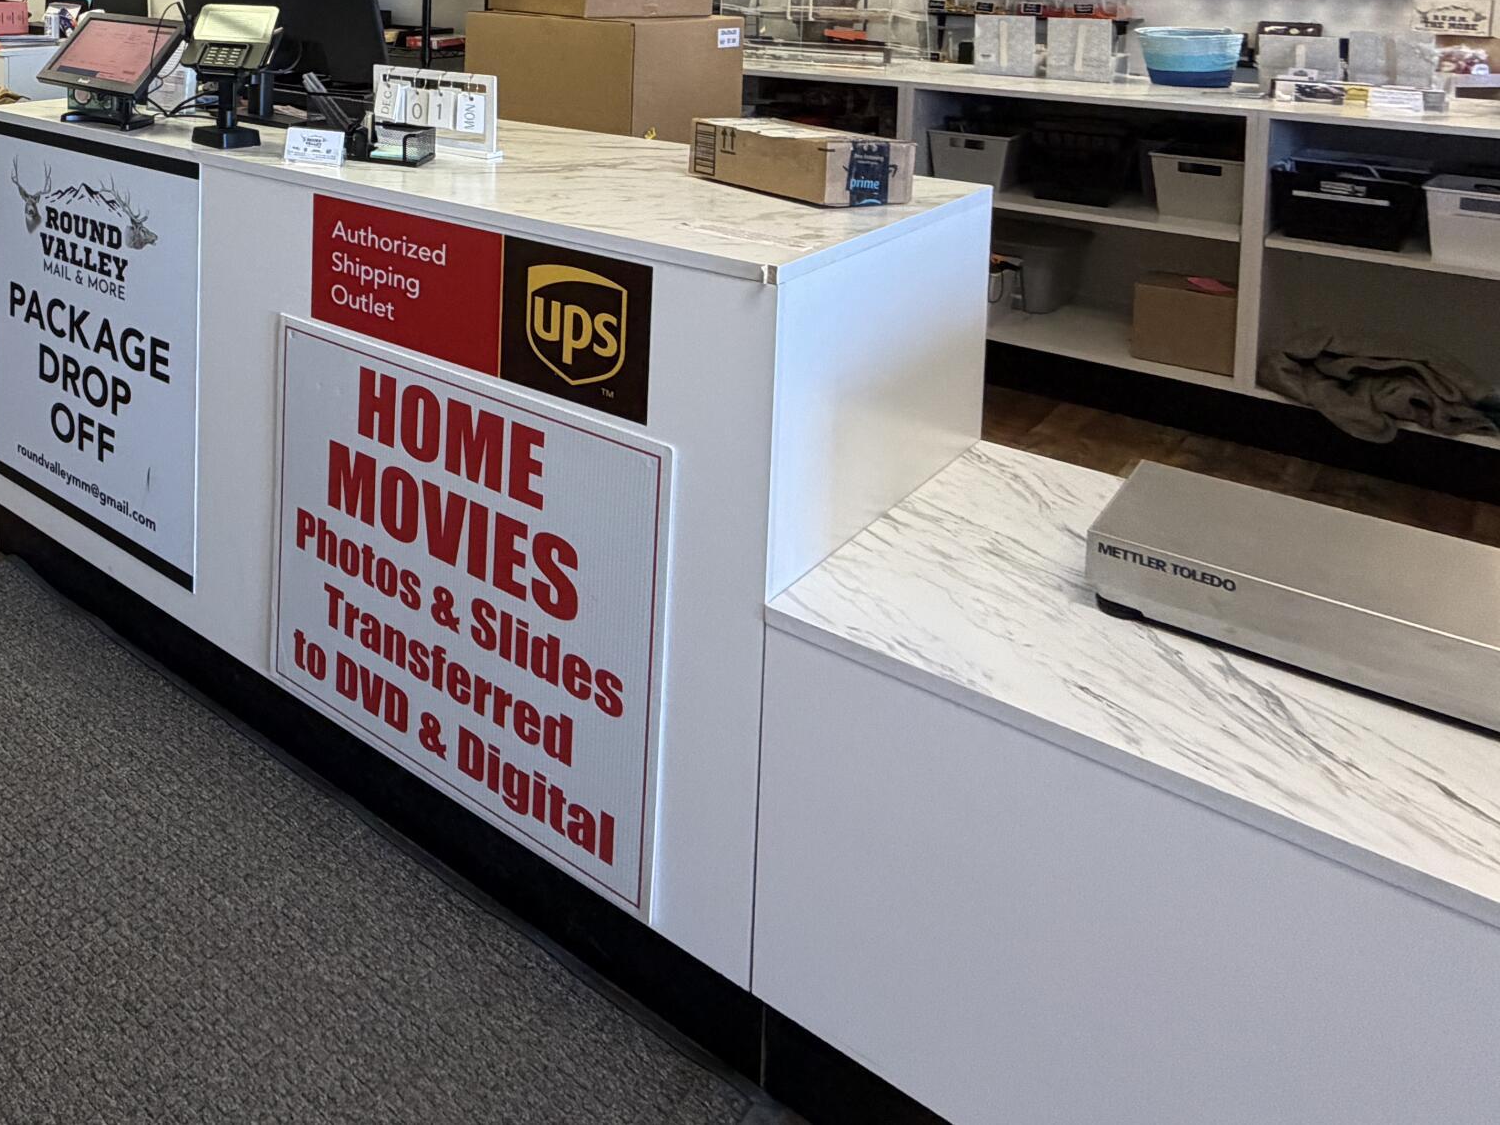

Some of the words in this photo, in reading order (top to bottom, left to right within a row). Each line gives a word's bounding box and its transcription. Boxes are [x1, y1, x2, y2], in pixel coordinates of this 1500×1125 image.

[380, 89, 393, 115] DEC
[464, 103, 477, 130] MON
[850, 175, 880, 190] prime
[40, 231, 129, 283] VALLEY
[45, 204, 123, 251] ROUND
[331, 219, 447, 267] Authorized
[42, 258, 72, 282] MAIL
[75, 268, 85, 286] &
[87, 272, 126, 301] MORE
[331, 251, 421, 300] Shipping
[331, 283, 396, 321] Outlet
[9, 280, 171, 385] PACKAGE
[534, 295, 618, 365] ups
[38, 342, 132, 416] DROP
[50, 401, 116, 464] OFF
[358, 365, 546, 511] HOME
[17, 442, 157, 533] roundvalleymm@gmail.com
[327, 439, 579, 622] MOVIES
[1097, 541, 1168, 573] METTLER
[1172, 561, 1237, 593] TOLEDO
[295, 506, 422, 612] Photos
[431, 585, 461, 635] &
[470, 597, 625, 719] Slides
[323, 581, 574, 768] Transferred
[293, 627, 328, 683] to
[334, 649, 409, 736] DVD
[419, 711, 447, 762] &
[457, 729, 615, 868] Digital
